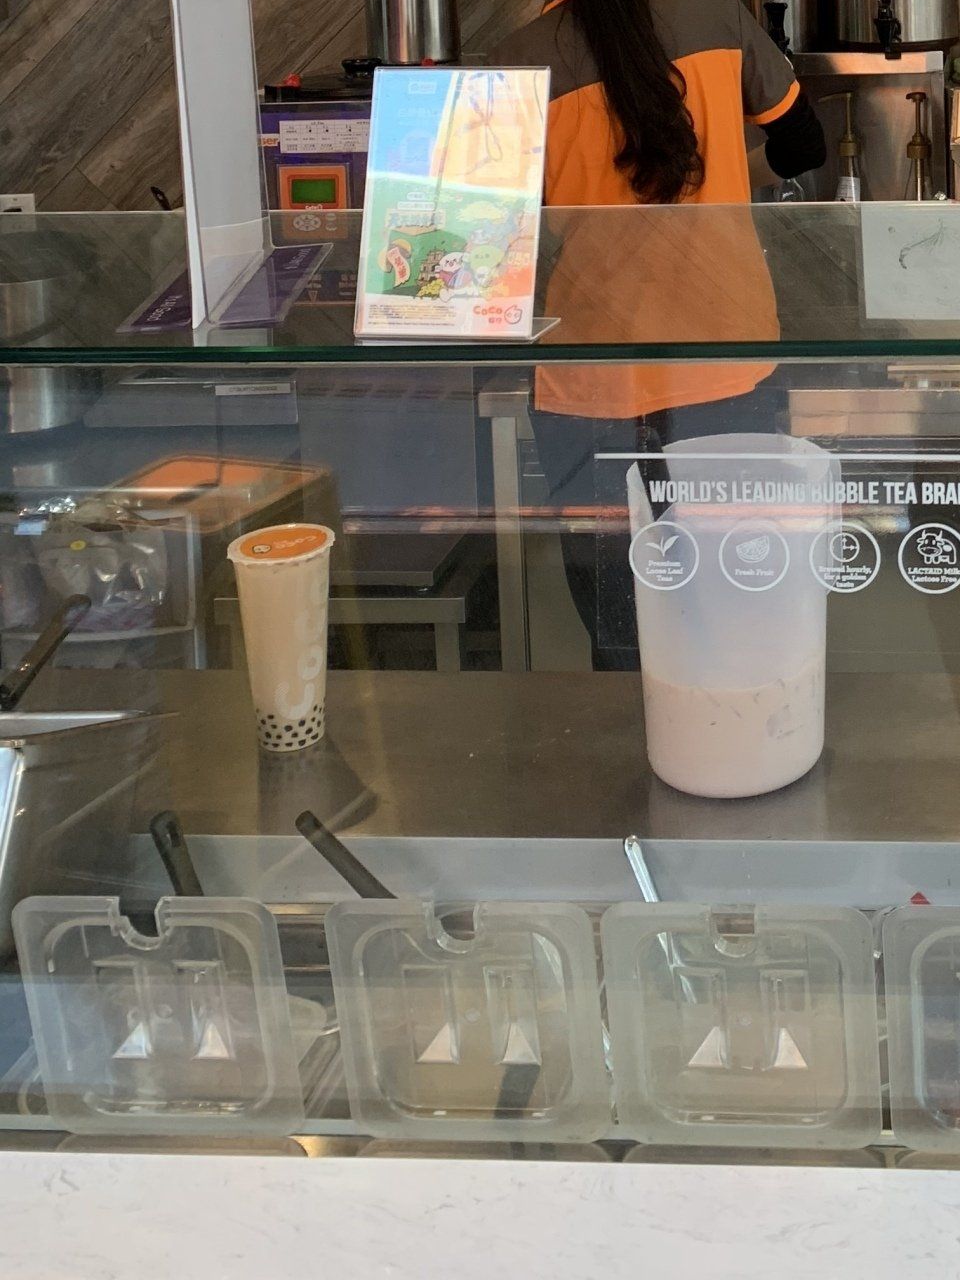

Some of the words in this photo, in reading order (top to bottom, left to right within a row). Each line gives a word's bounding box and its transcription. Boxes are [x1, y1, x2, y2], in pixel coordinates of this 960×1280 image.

[473, 306, 502, 316] CoCo
[649, 481, 727, 503] WORLD'S
[732, 481, 806, 503] LEADING
[811, 481, 879, 504] BUBBLE
[884, 482, 917, 504] TEA
[847, 566, 872, 574] hourly,
[842, 574, 866, 582] golden
